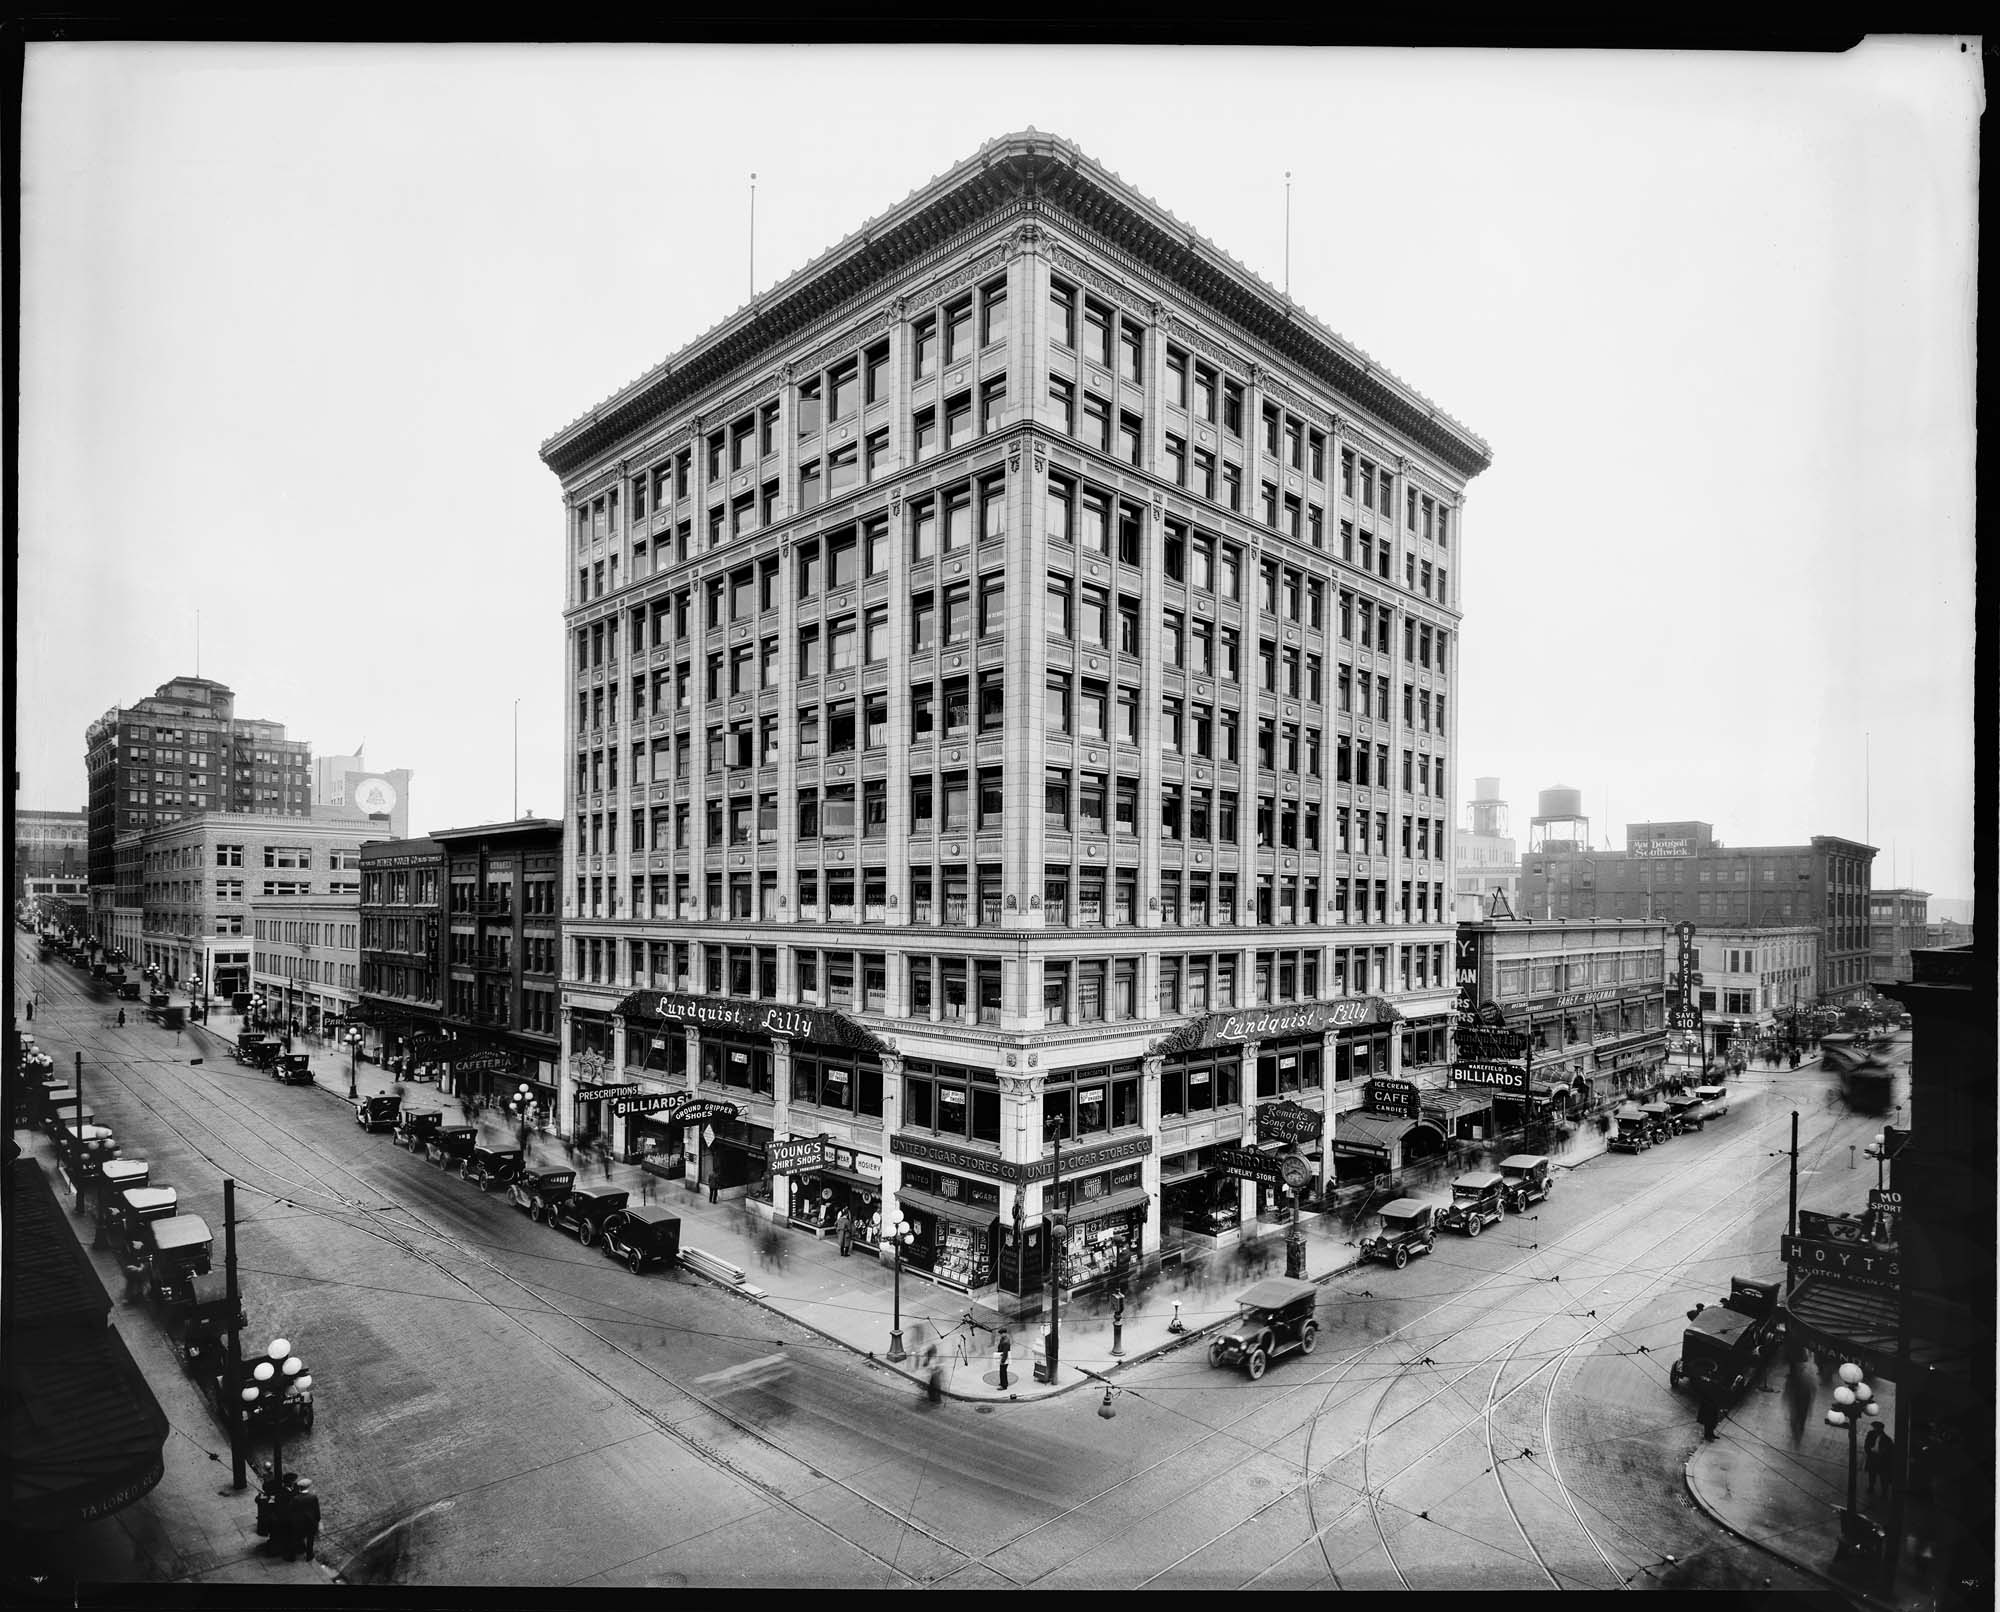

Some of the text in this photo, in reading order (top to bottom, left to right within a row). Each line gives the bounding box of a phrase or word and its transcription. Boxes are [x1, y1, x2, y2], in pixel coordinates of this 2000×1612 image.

[655, 996, 813, 1037] Lundquist Lilly
[1216, 1001, 1369, 1040] Lundquist Lilly
[1677, 1019, 1694, 1028] $10
[456, 1057, 512, 1071] CAFETERIA
[1469, 1064, 1507, 1073] WAKEFIELD'S
[1387, 1082, 1409, 1090] CREAM
[1454, 1069, 1523, 1087] BILLIARDS
[579, 1085, 638, 1101] PRESCRIPTIONS
[1374, 1091, 1409, 1104] CAFE
[617, 1095, 686, 1114] BILLIARDS
[675, 1103, 733, 1120] GROUND GRIPPER
[1267, 1104, 1309, 1121] Remick's
[1376, 1104, 1408, 1114] CANDIES
[685, 1110, 713, 1121] SHOES
[1260, 1115, 1286, 1131] Song
[1296, 1121, 1317, 1132] Gift
[1270, 1127, 1298, 1144] Shop
[773, 1142, 821, 1159] YOUNG'S
[772, 1159, 793, 1170] SHIRT
[796, 1155, 821, 1166] SHOPS
[857, 1160, 881, 1172] HOSIERY
[893, 1139, 1018, 1179] UNITED CIGAR STORES CO.
[1027, 1160, 1066, 1178] UNITD
[1068, 1152, 1097, 1168] CIGAR
[1100, 1144, 1135, 1161] STORES
[1114, 1172, 1137, 1185] CIGARS
[1227, 1167, 1276, 1183] JEWELRY STORE
[1045, 1191, 1066, 1203] UNTE
